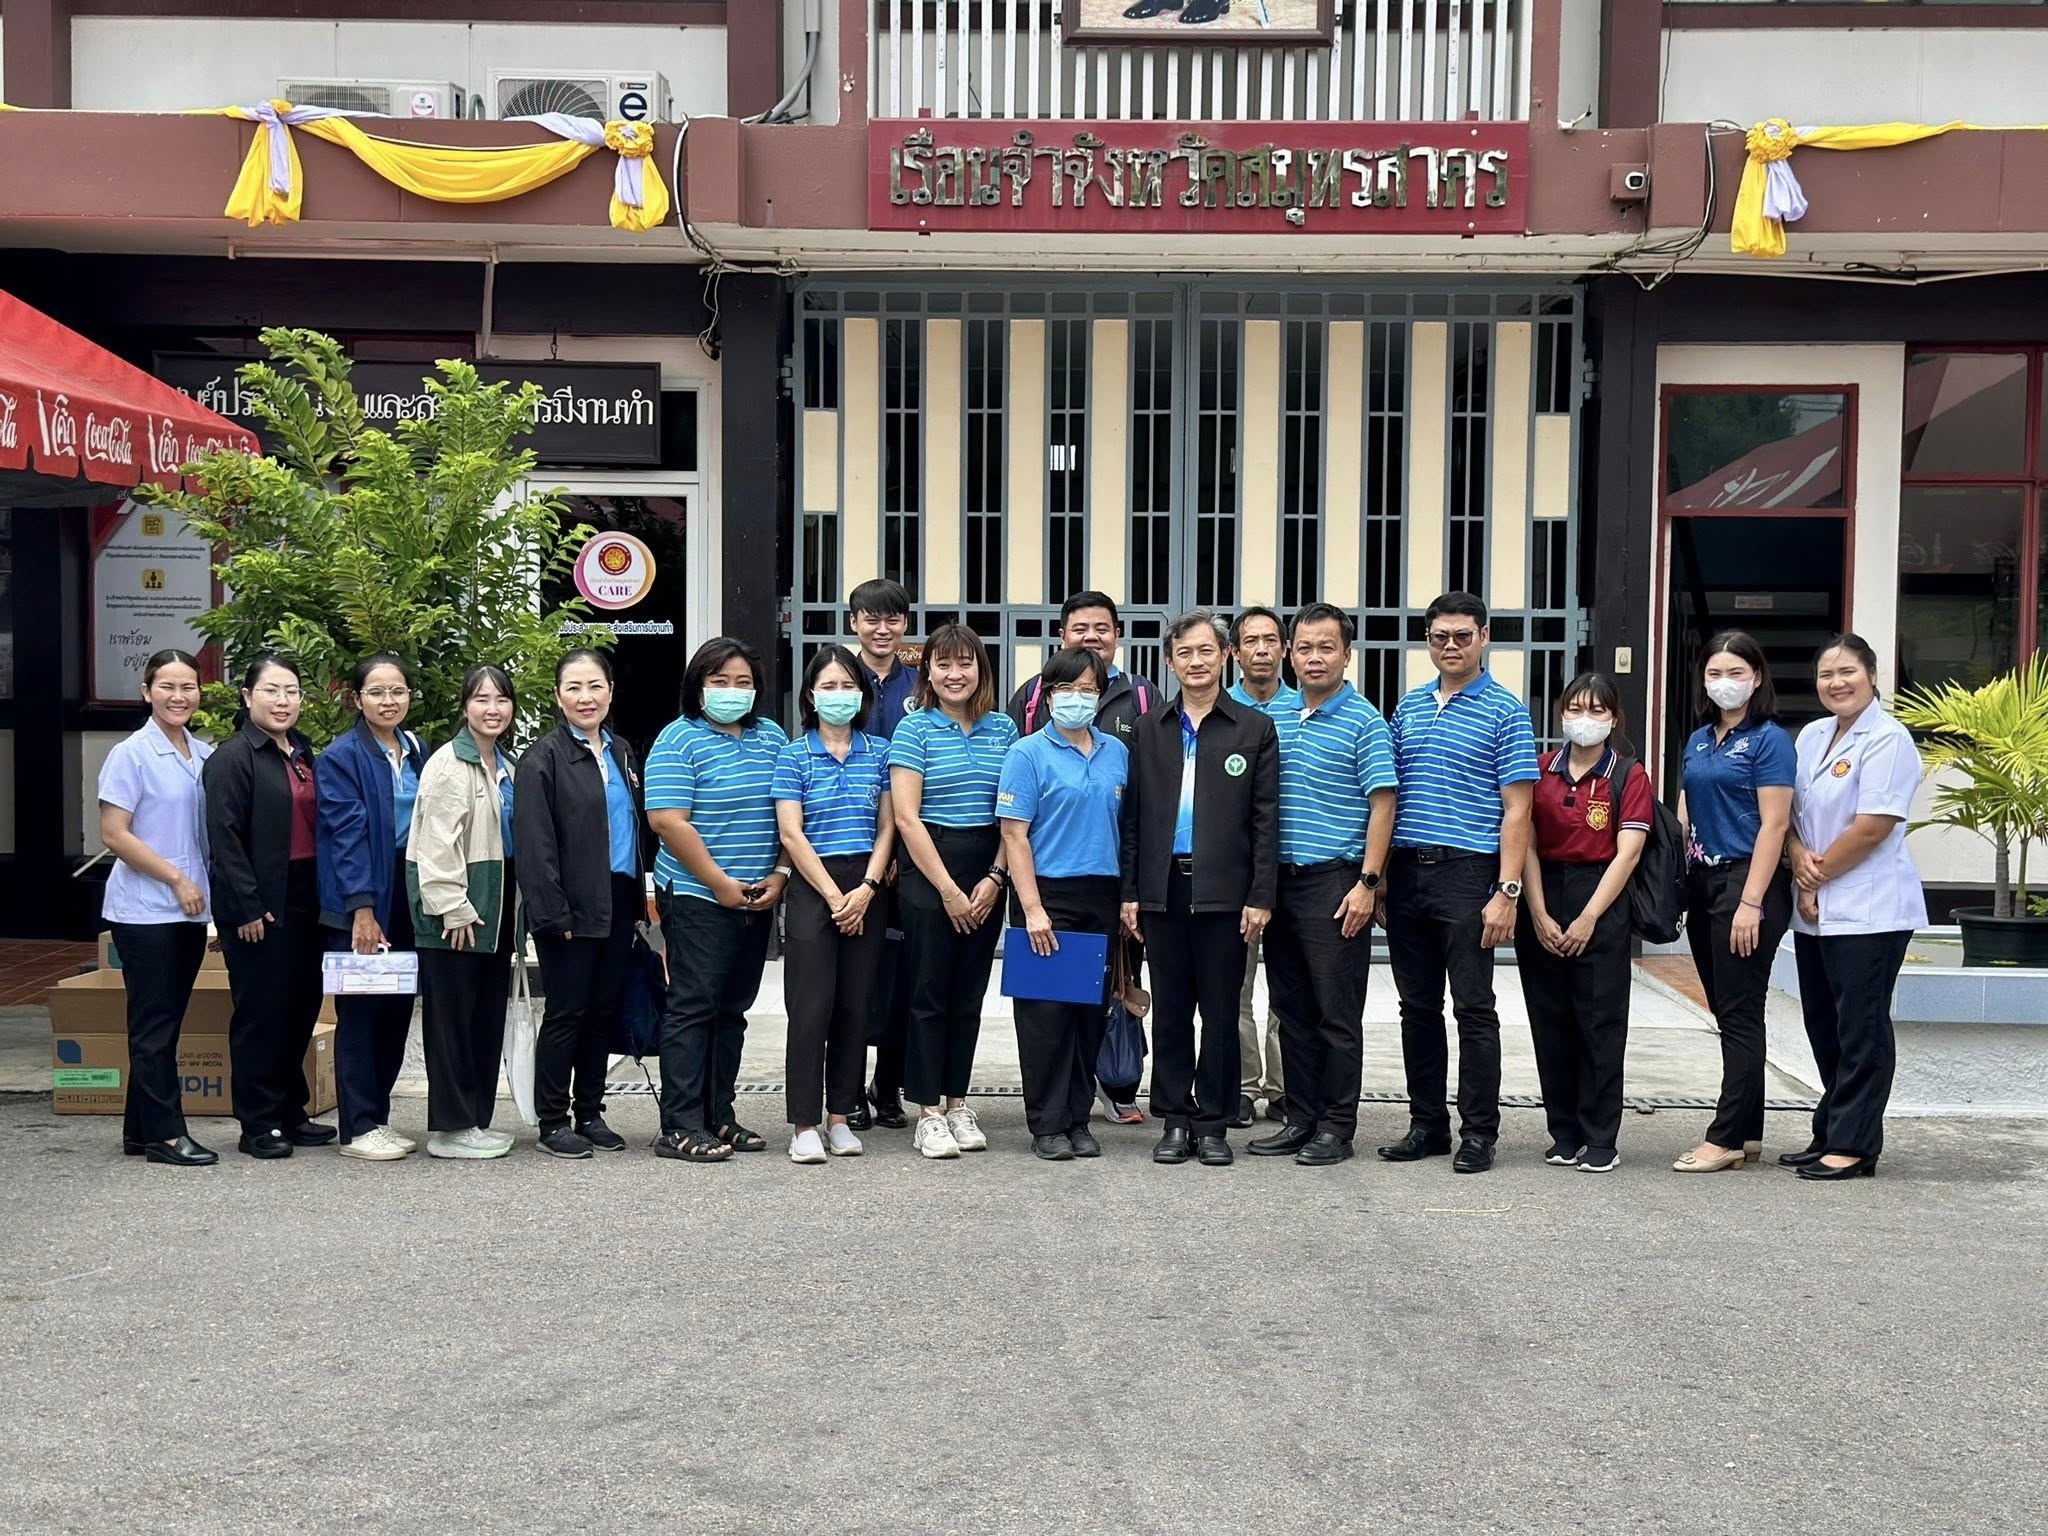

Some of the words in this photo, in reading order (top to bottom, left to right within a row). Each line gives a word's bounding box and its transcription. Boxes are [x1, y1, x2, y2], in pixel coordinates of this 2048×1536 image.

[890, 130, 1508, 225] เรือนจำจังหวัดสมุทรสาคร
[598, 585, 632, 596] CARE
[109, 628, 152, 646] เราพร้อม
